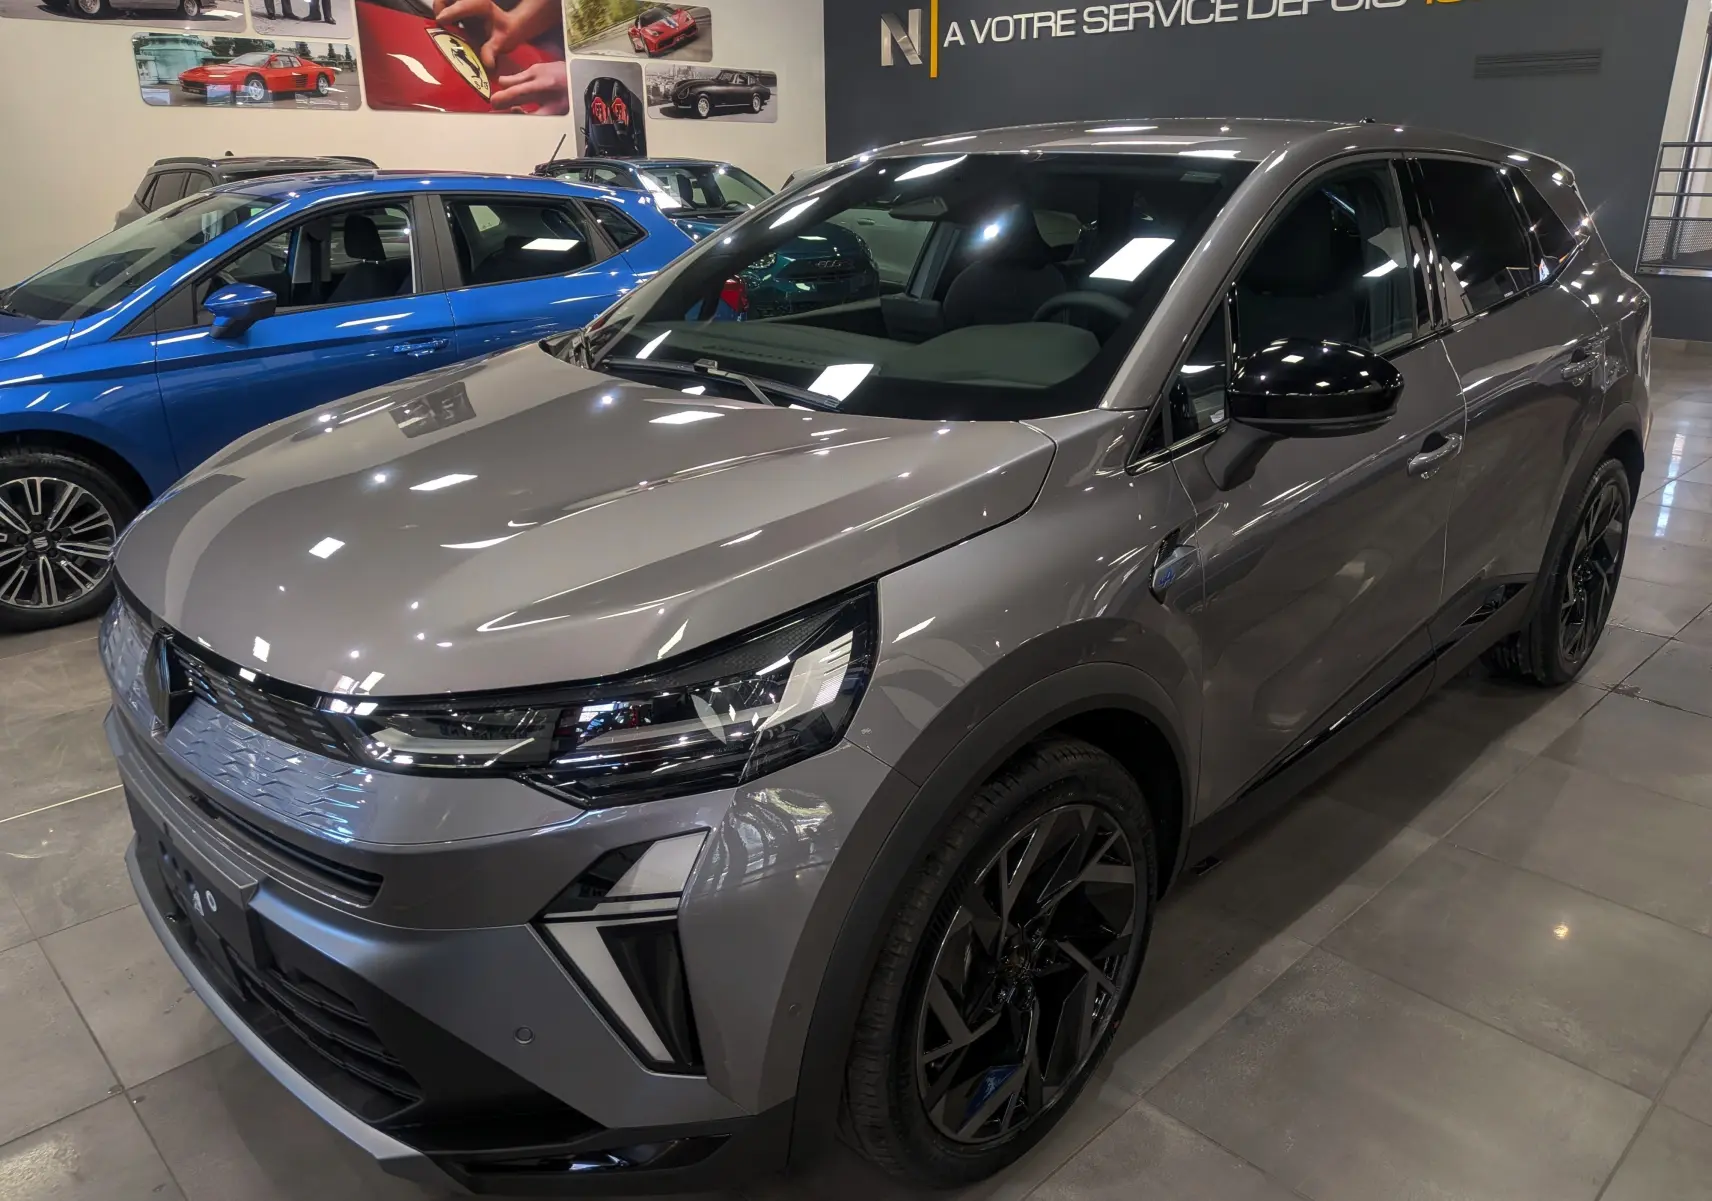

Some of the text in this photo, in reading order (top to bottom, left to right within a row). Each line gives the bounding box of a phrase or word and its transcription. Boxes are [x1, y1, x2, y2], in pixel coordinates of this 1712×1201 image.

[943, 21, 966, 47] A
[970, 8, 1077, 44] VOTRE
[1083, 0, 1239, 34] SERVICE
